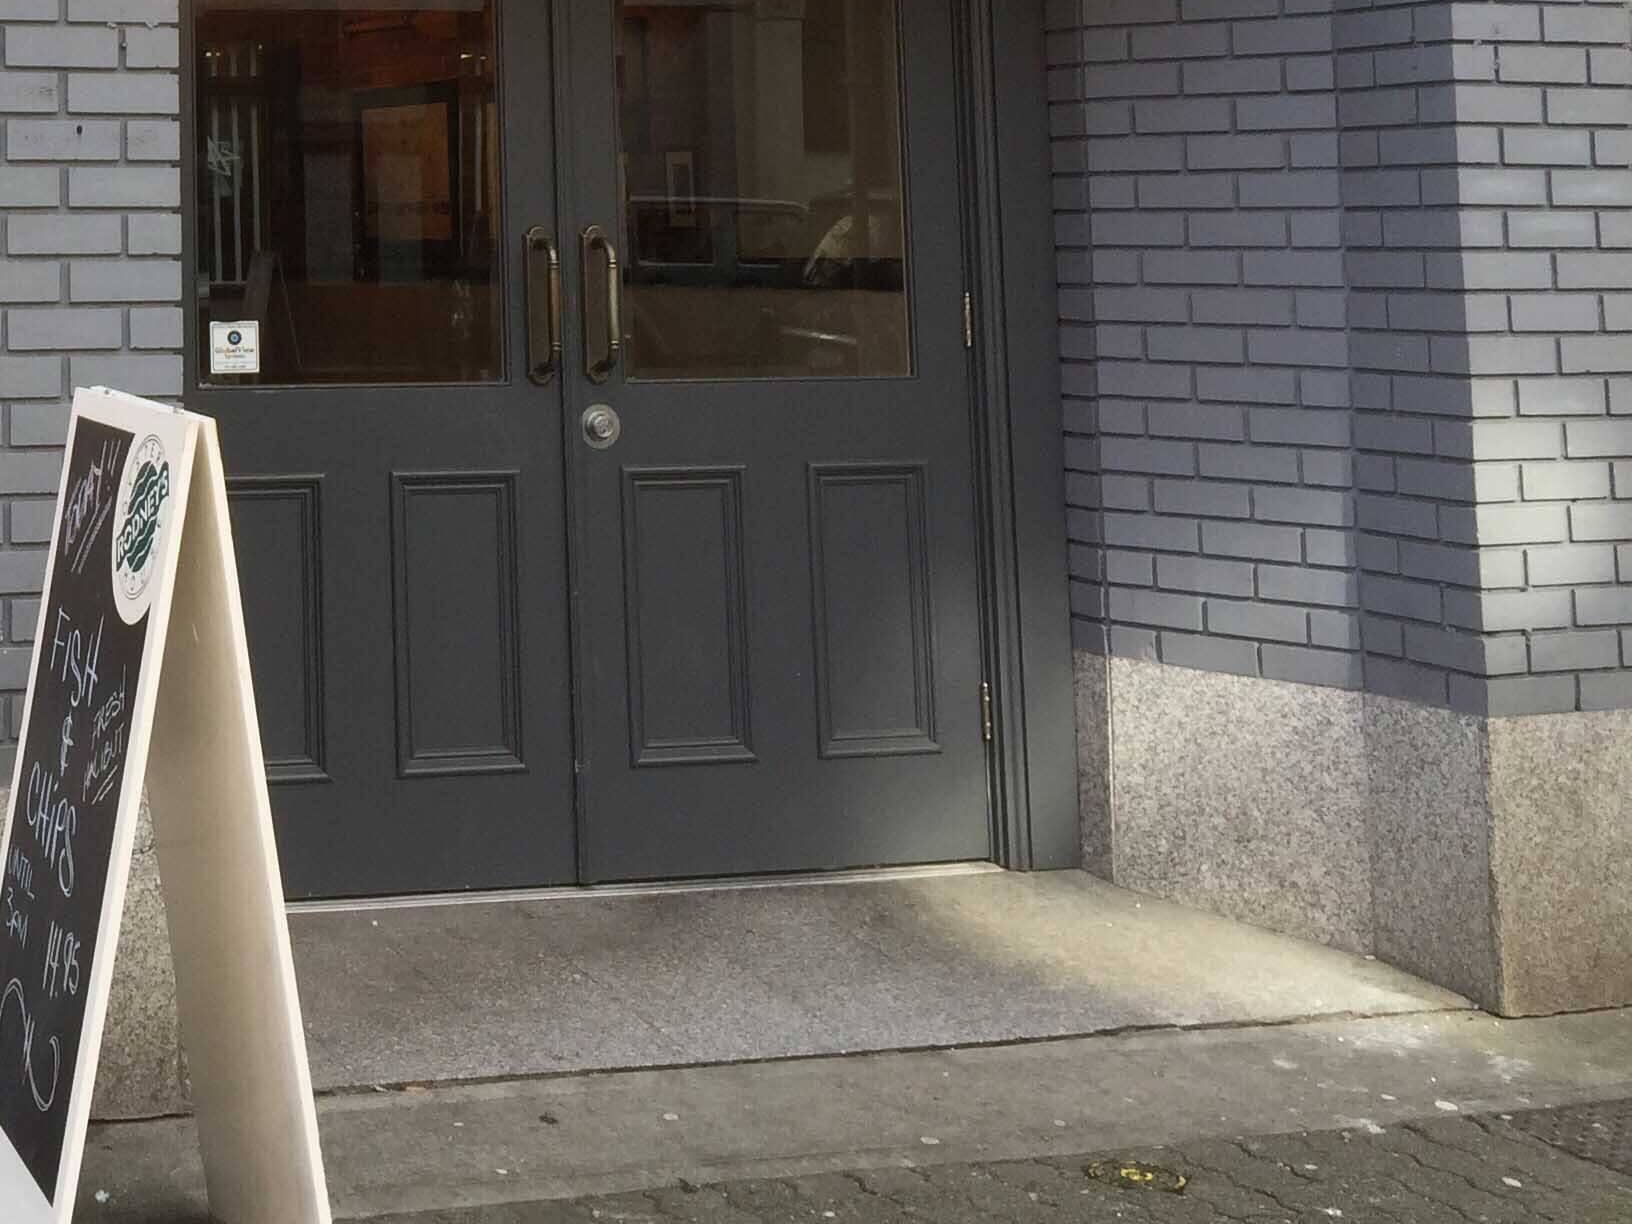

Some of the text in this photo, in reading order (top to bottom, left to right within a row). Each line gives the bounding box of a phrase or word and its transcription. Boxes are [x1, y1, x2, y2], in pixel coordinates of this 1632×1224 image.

[50, 606, 105, 708] FISH
[92, 664, 127, 750] FRESH
[7, 844, 35, 899] UNTIL
[42, 920, 81, 998] 14.95
